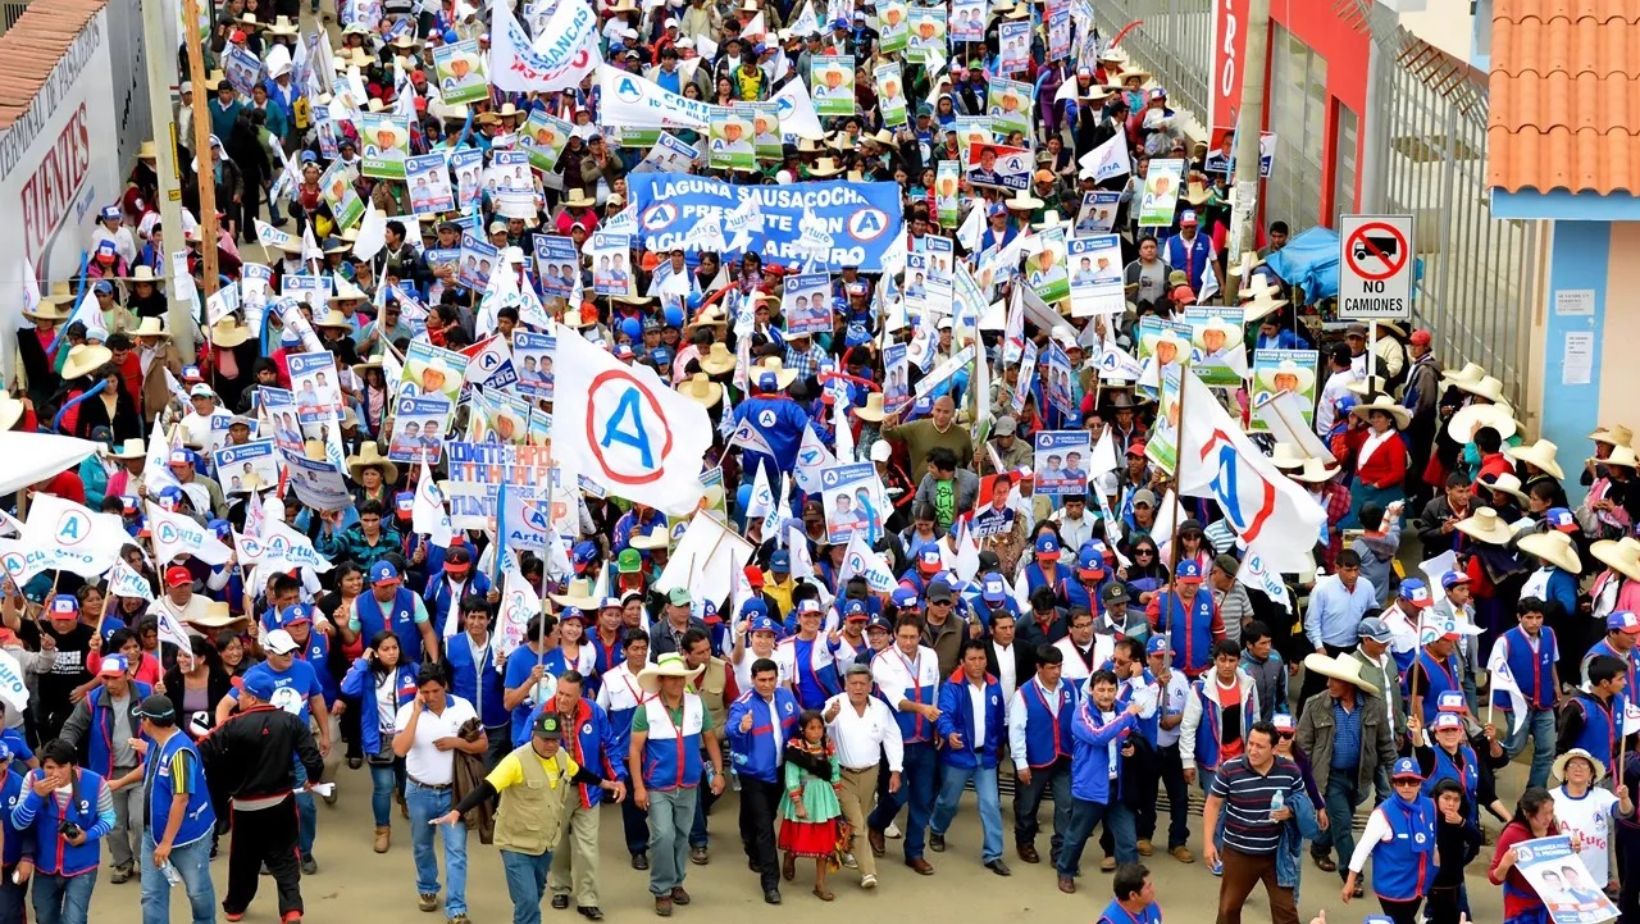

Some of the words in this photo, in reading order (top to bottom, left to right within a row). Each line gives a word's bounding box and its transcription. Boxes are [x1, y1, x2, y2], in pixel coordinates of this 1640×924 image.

[619, 77, 640, 95] A
[0, 92, 45, 182] TERMINAL
[46, 74, 57, 119] DE
[1010, 159, 1019, 169] A
[21, 100, 90, 264] FUENTES
[652, 180, 732, 200] LAGUNA
[647, 206, 669, 223] A
[856, 211, 880, 232] A
[1363, 280, 1385, 293] NO
[1345, 298, 1403, 311] CAMIONES
[485, 354, 497, 368] A
[1103, 353, 1116, 369] A
[762, 413, 773, 424] A
[601, 387, 654, 469] A
[1209, 444, 1245, 529] A
[60, 516, 78, 539] A
[531, 512, 547, 528] A
